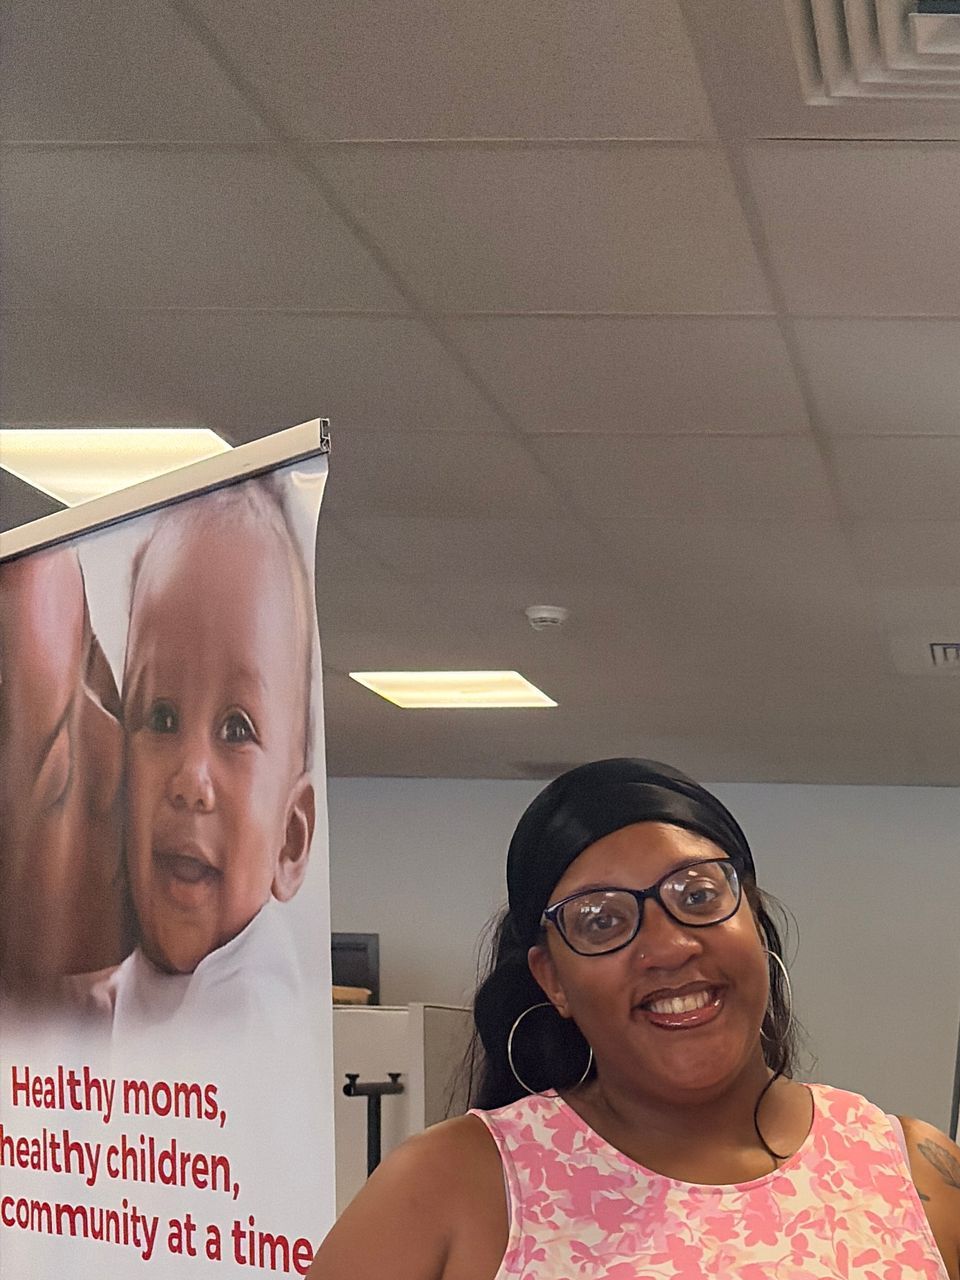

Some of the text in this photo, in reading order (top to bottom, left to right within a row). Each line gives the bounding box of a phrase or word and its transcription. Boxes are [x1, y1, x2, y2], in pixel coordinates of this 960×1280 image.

[11, 1065, 227, 1128] Healthy moms,
[0, 1124, 241, 1200] healthy children,
[1, 1196, 314, 1276] community at a time
